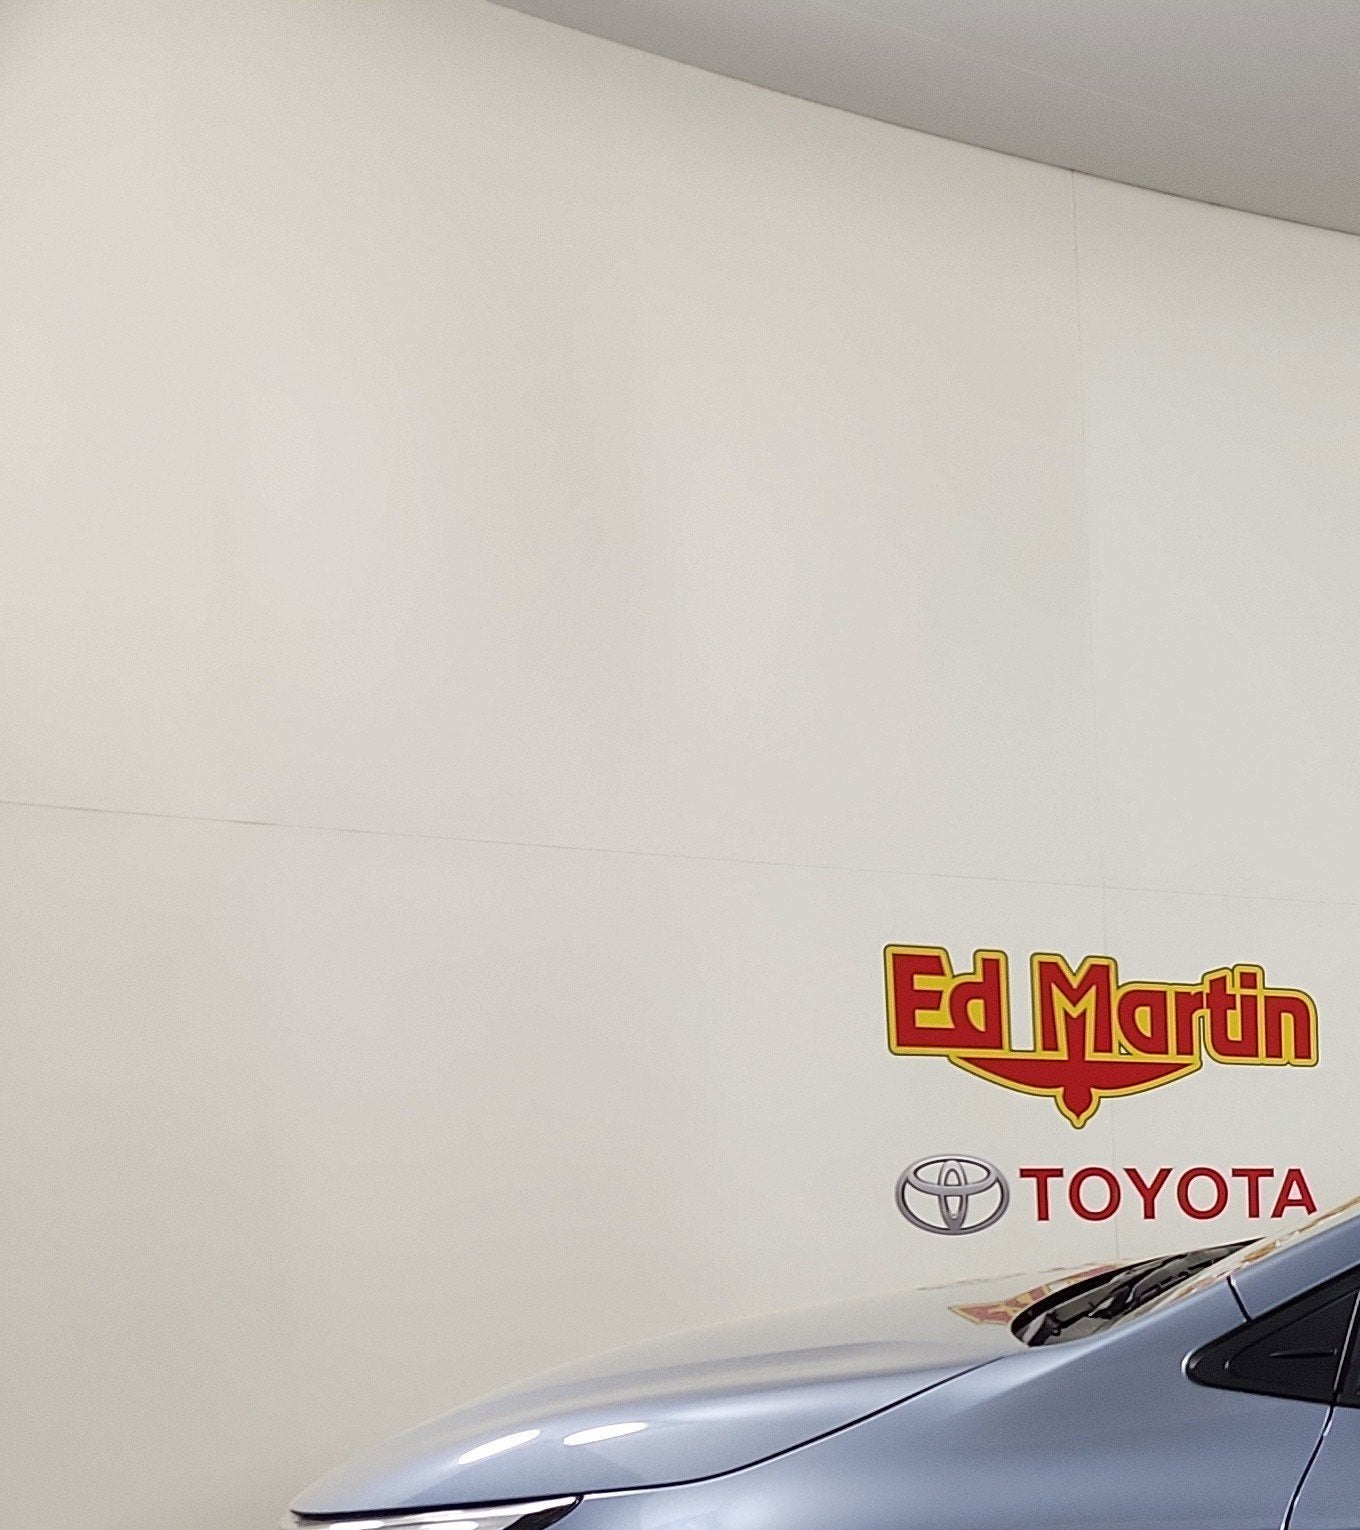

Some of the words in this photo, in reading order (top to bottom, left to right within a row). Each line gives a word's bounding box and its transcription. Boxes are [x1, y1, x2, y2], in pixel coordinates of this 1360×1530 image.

[890, 950, 1004, 1051] Ed
[1035, 957, 1316, 1062] Martin
[1018, 1167, 1318, 1222] TOYOTA
